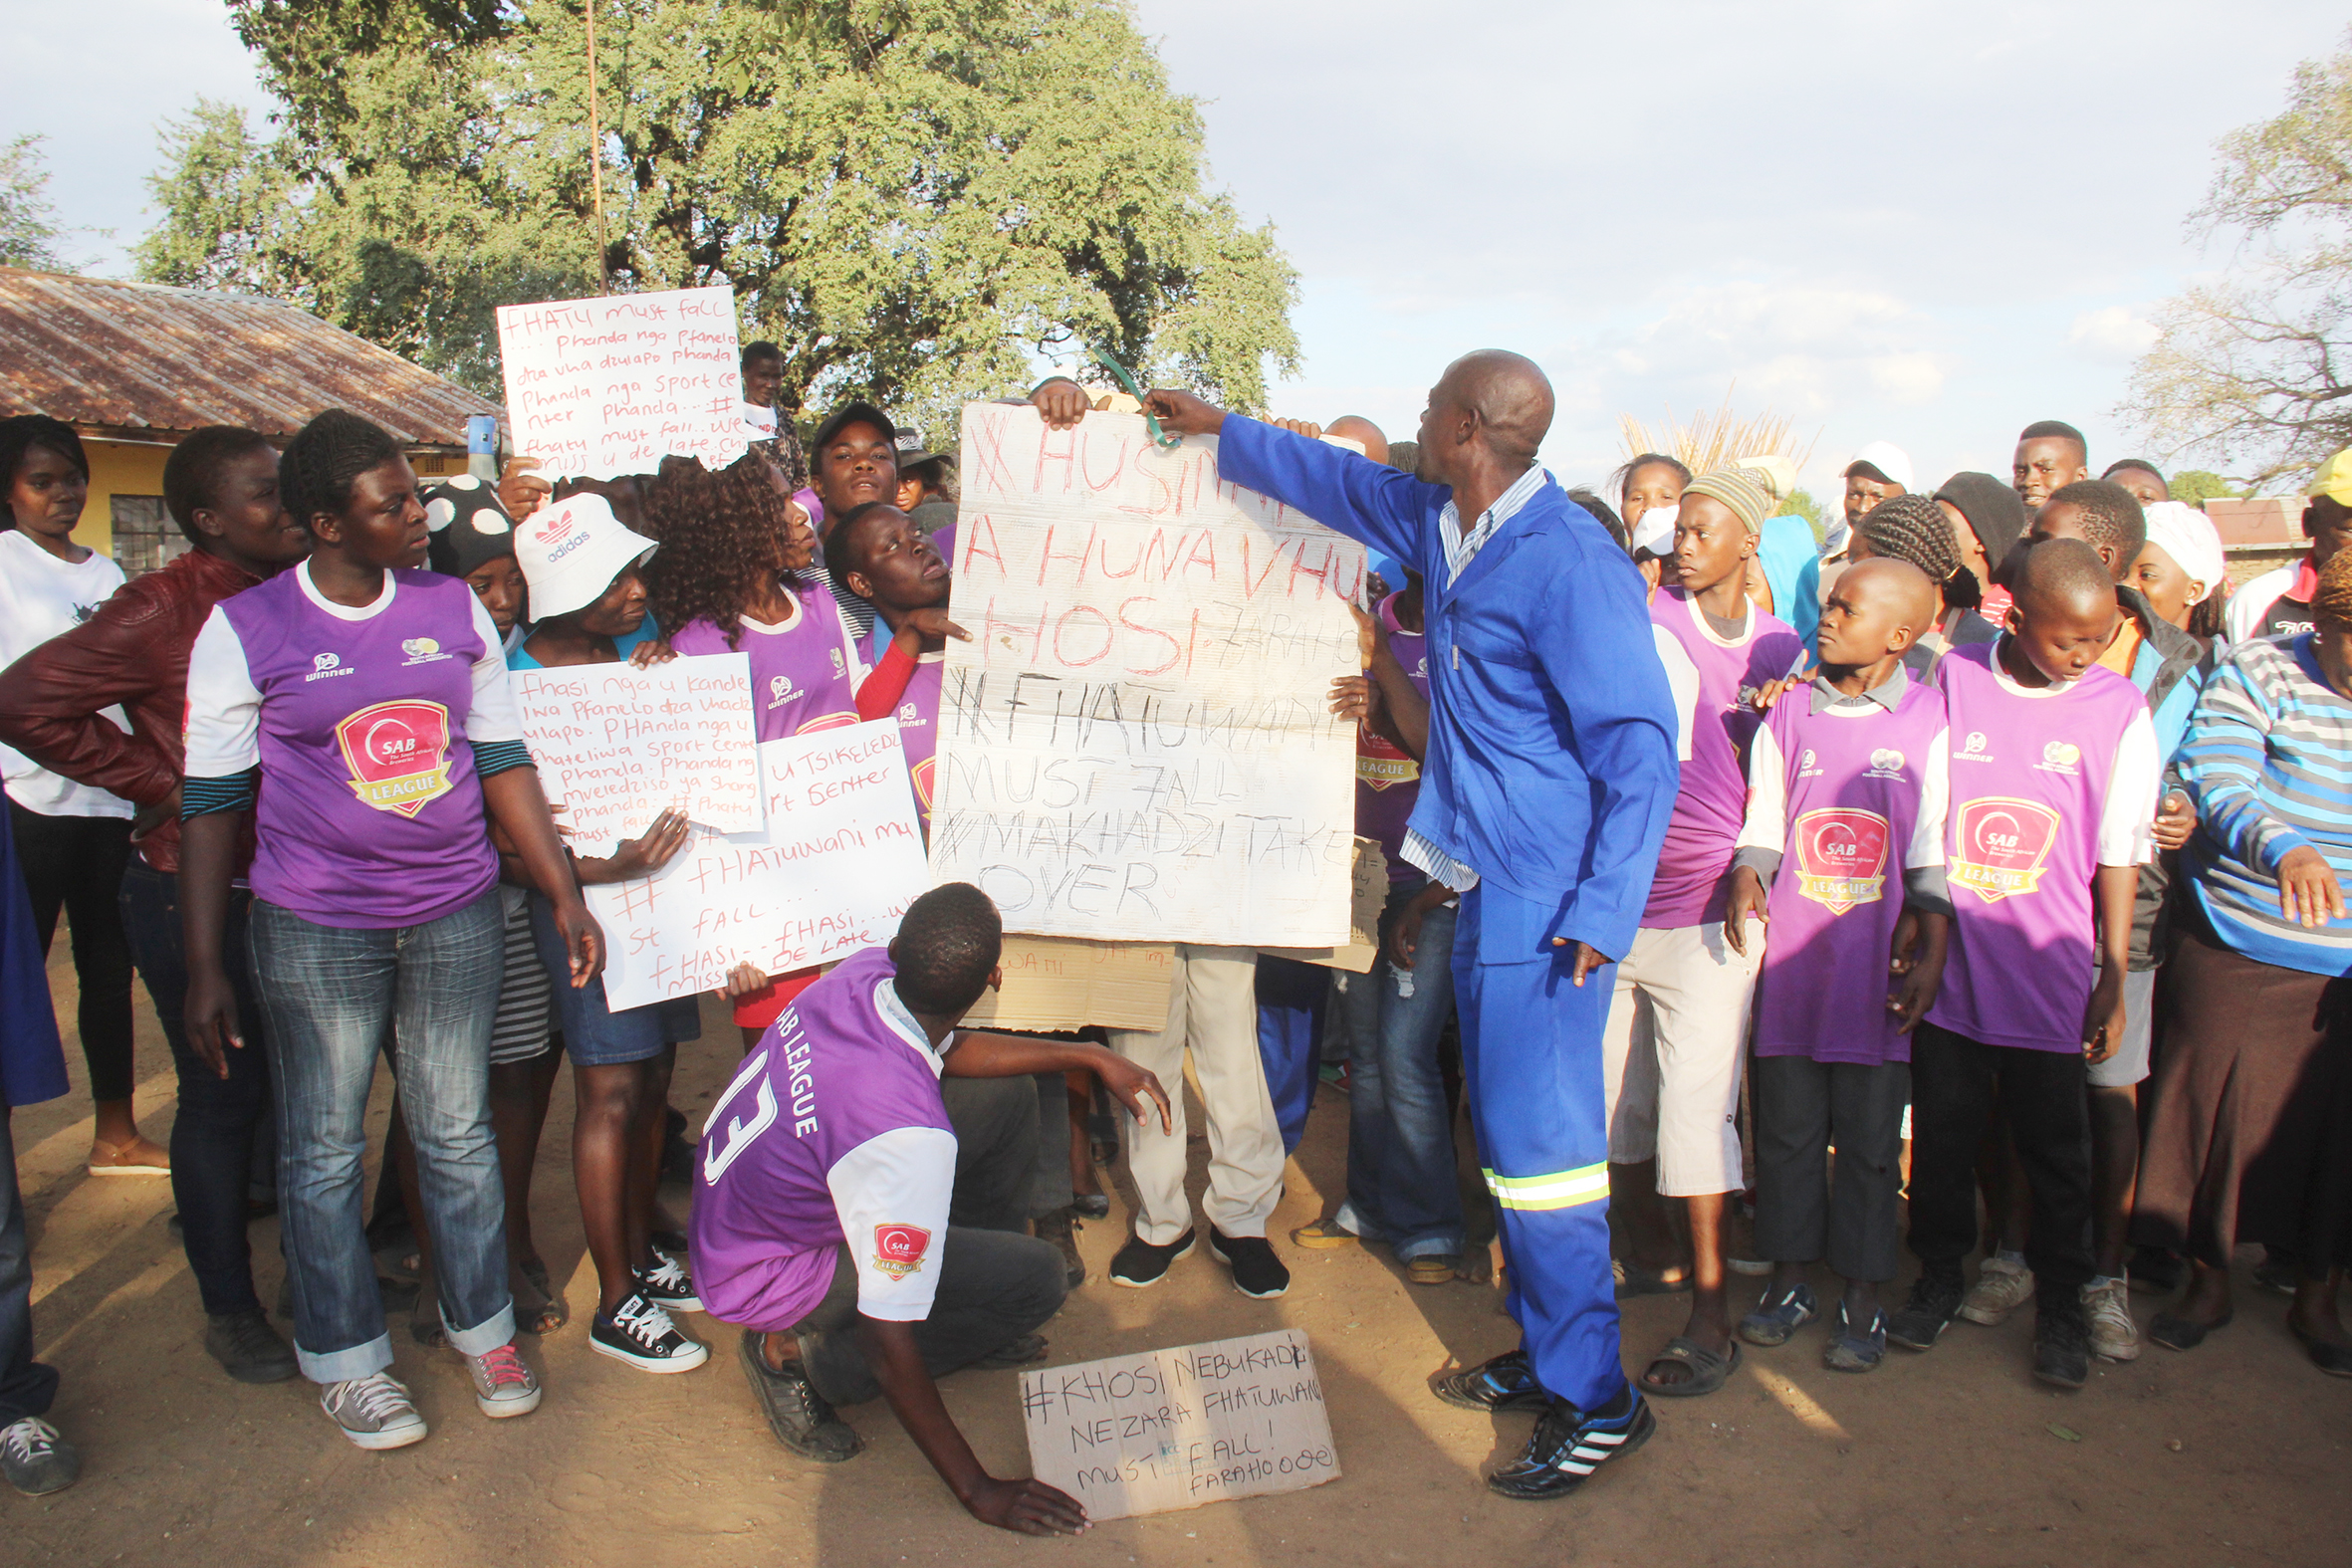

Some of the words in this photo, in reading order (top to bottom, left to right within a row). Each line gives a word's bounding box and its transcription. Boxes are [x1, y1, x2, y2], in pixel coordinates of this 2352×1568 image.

[636, 330, 667, 346] nga
[606, 381, 641, 405] nga
[547, 531, 590, 562] adidas
[305, 667, 355, 682] WINNER
[768, 689, 805, 710] WINNER
[381, 738, 416, 756] SAB
[1953, 751, 1995, 764] WINNER
[1356, 761, 1405, 775] LEAGUE
[371, 776, 436, 801] LEAGUE
[943, 751, 1116, 813] MUST
[1235, 813, 1354, 877] TAKE
[1825, 842, 1857, 856] SAB
[1986, 832, 2018, 847] SAB
[1963, 867, 2023, 887] LEAGUE
[978, 861, 1162, 922] OVER
[1812, 880, 1868, 895] LEAGUE
[783, 1028, 819, 1138] LEAGUE
[891, 1241, 910, 1251] SAB
[1070, 1401, 1192, 1454] NEZARA
